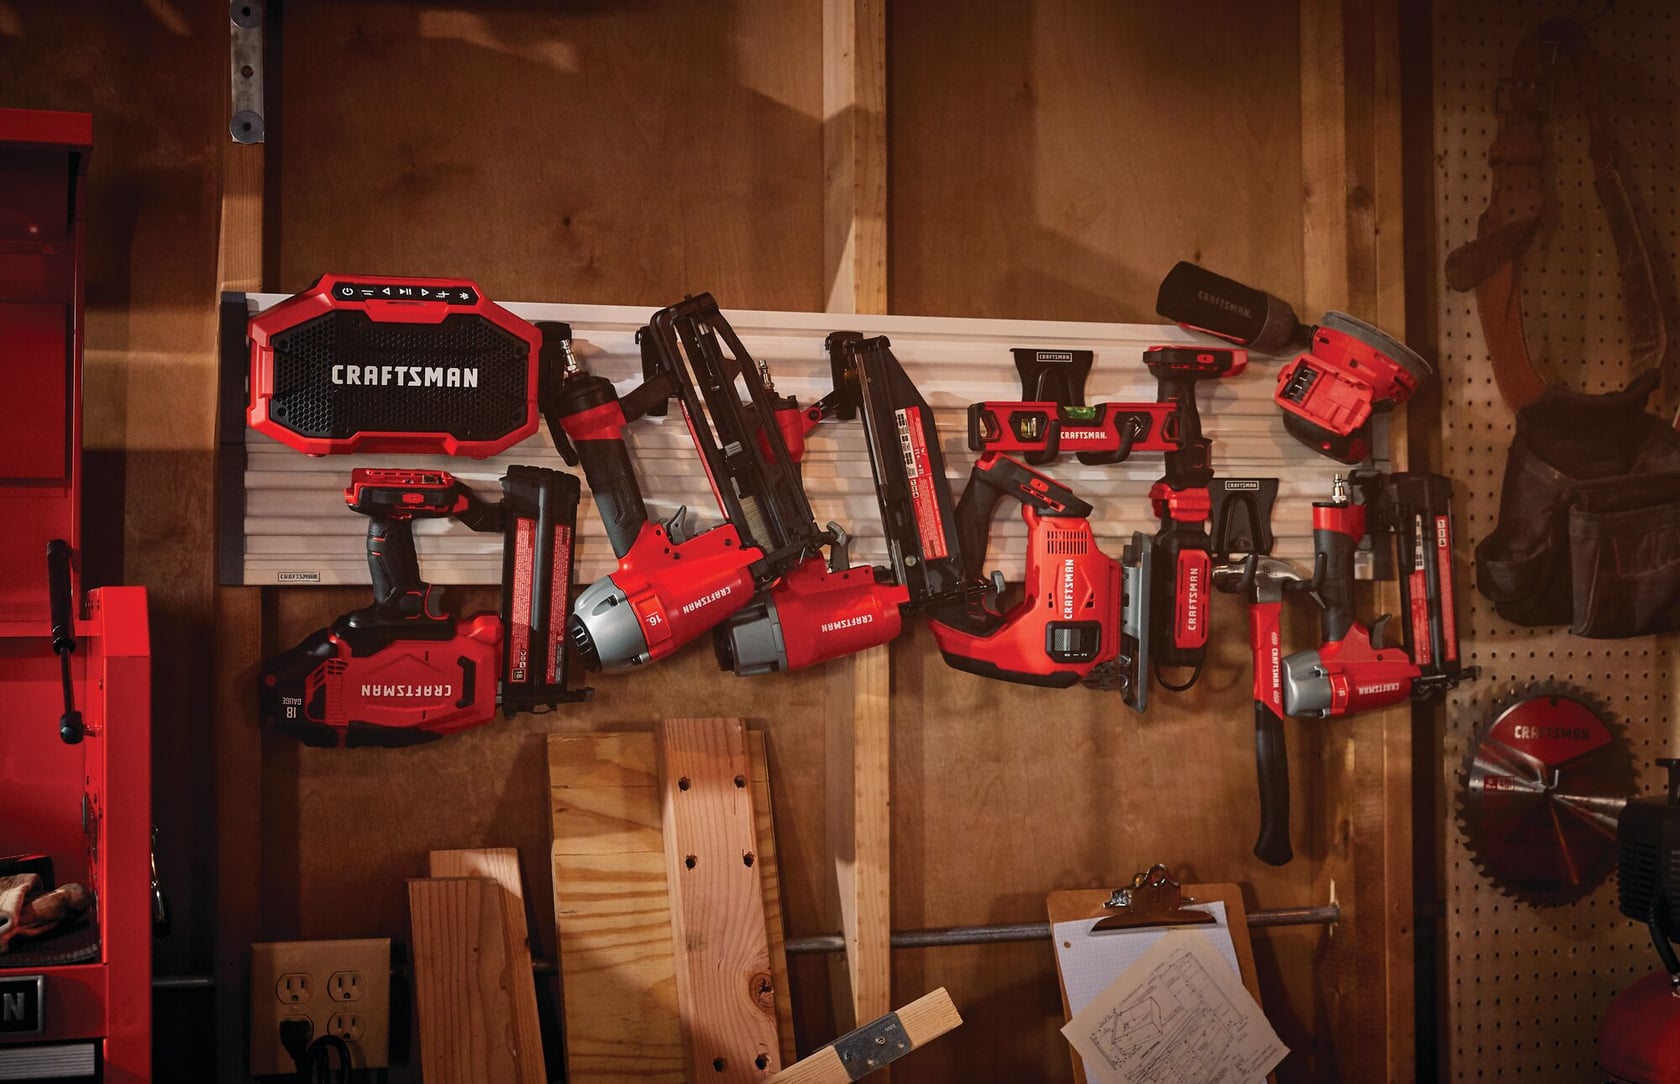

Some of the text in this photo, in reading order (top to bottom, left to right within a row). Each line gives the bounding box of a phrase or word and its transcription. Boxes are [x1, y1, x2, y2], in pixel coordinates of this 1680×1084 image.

[1197, 290, 1254, 318] CRAFTSMAN
[331, 364, 479, 388] CRAFTSMAN
[1060, 431, 1107, 440] CRAFTSMAN
[1064, 558, 1074, 620] CRAFTSMAN
[683, 586, 732, 614] CRAFTSMAN
[1187, 566, 1198, 631] CRAFTSMAN
[821, 614, 873, 632] CRAFTSMAN
[1271, 648, 1279, 688] CRAFTSMAN
[360, 684, 453, 697] CRAFTSMAN
[1358, 682, 1400, 695] CRAFTSMAN
[282, 696, 302, 706] GAUGE
[286, 706, 297, 720] 18
[1514, 725, 1590, 740] CRAFTSMAN
